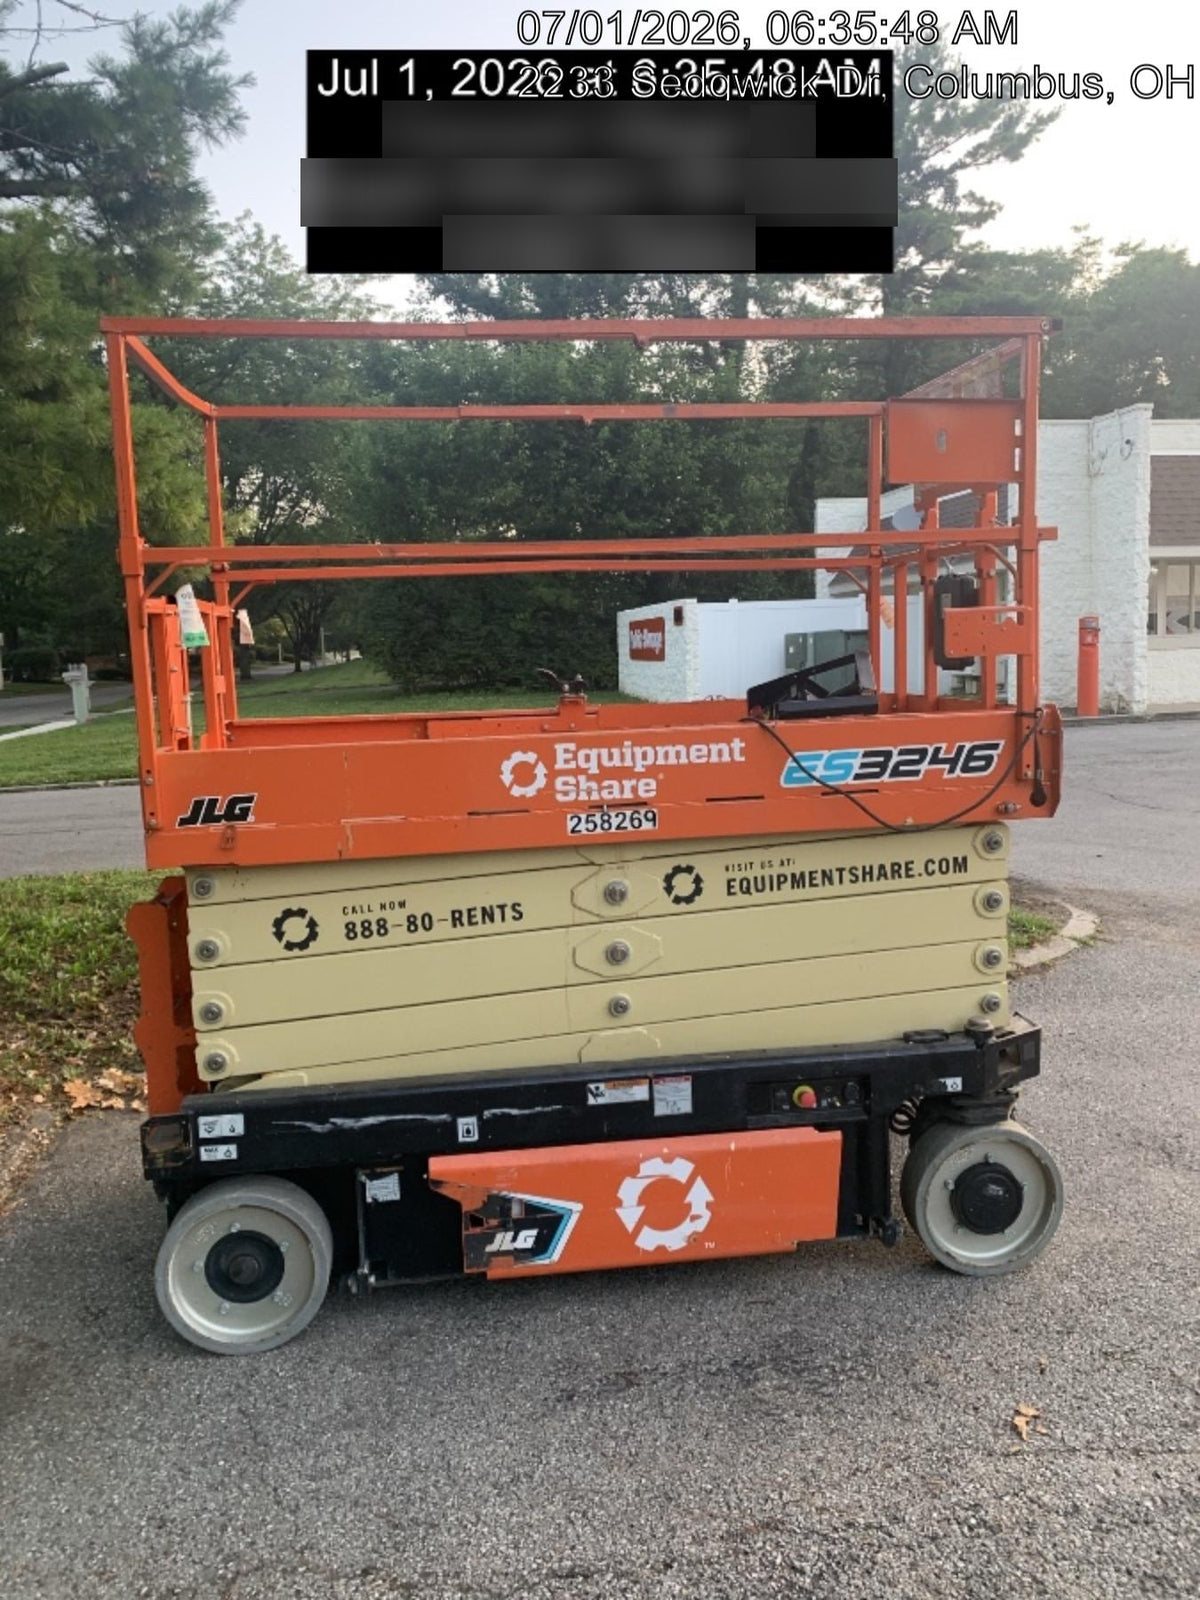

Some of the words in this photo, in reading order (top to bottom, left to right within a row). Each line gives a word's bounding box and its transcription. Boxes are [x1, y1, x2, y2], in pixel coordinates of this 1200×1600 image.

[554, 737, 746, 774] Equipment
[780, 740, 1005, 788] ES3246
[176, 792, 258, 829] JLG
[569, 809, 657, 835] 258269
[726, 855, 969, 897] EQUIPMENTSHARE.COM
[342, 904, 374, 916] CALL
[380, 899, 407, 912] NOW
[344, 902, 524, 941] 888-80-RENTS
[484, 1228, 539, 1252] JLG
